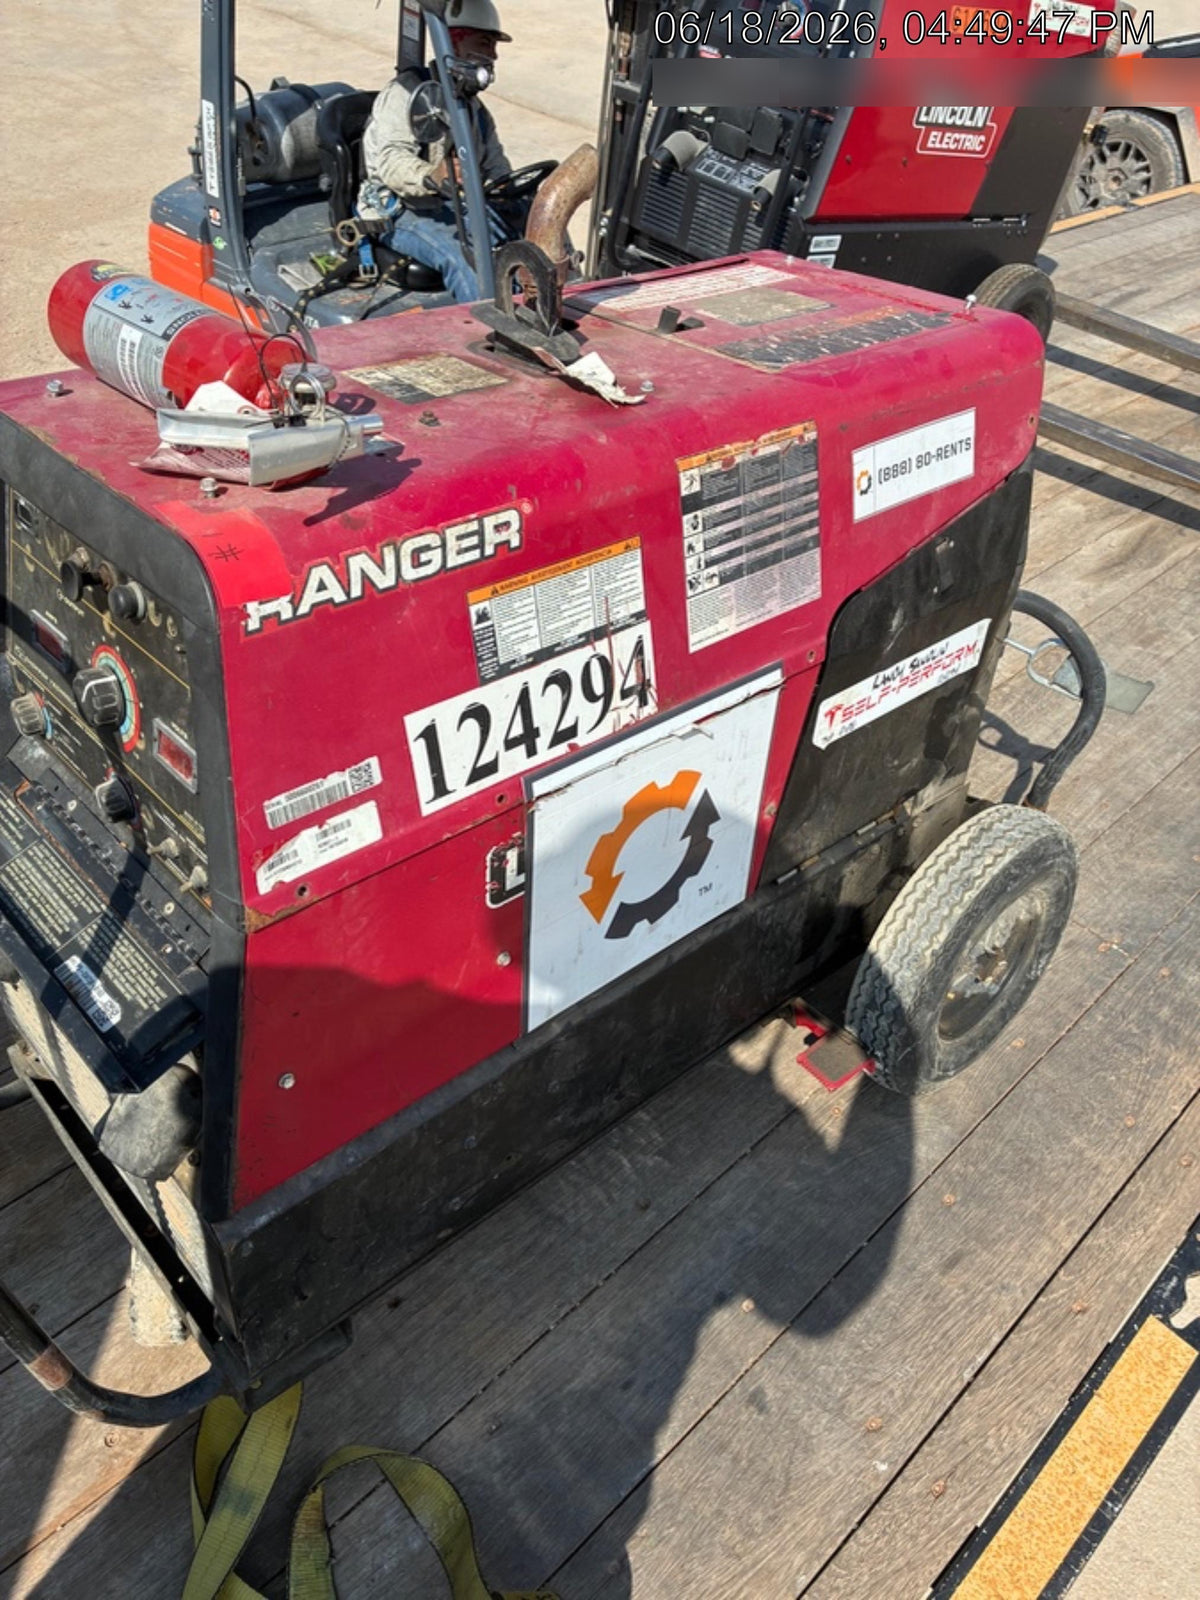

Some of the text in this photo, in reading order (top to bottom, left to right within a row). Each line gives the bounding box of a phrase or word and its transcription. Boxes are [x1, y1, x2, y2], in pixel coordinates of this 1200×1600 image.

[918, 106, 989, 128] LINCOLN
[926, 130, 986, 152] ELECTRIC
[878, 436, 971, 485] (888) 80-RENTS
[412, 634, 652, 804] 124294
